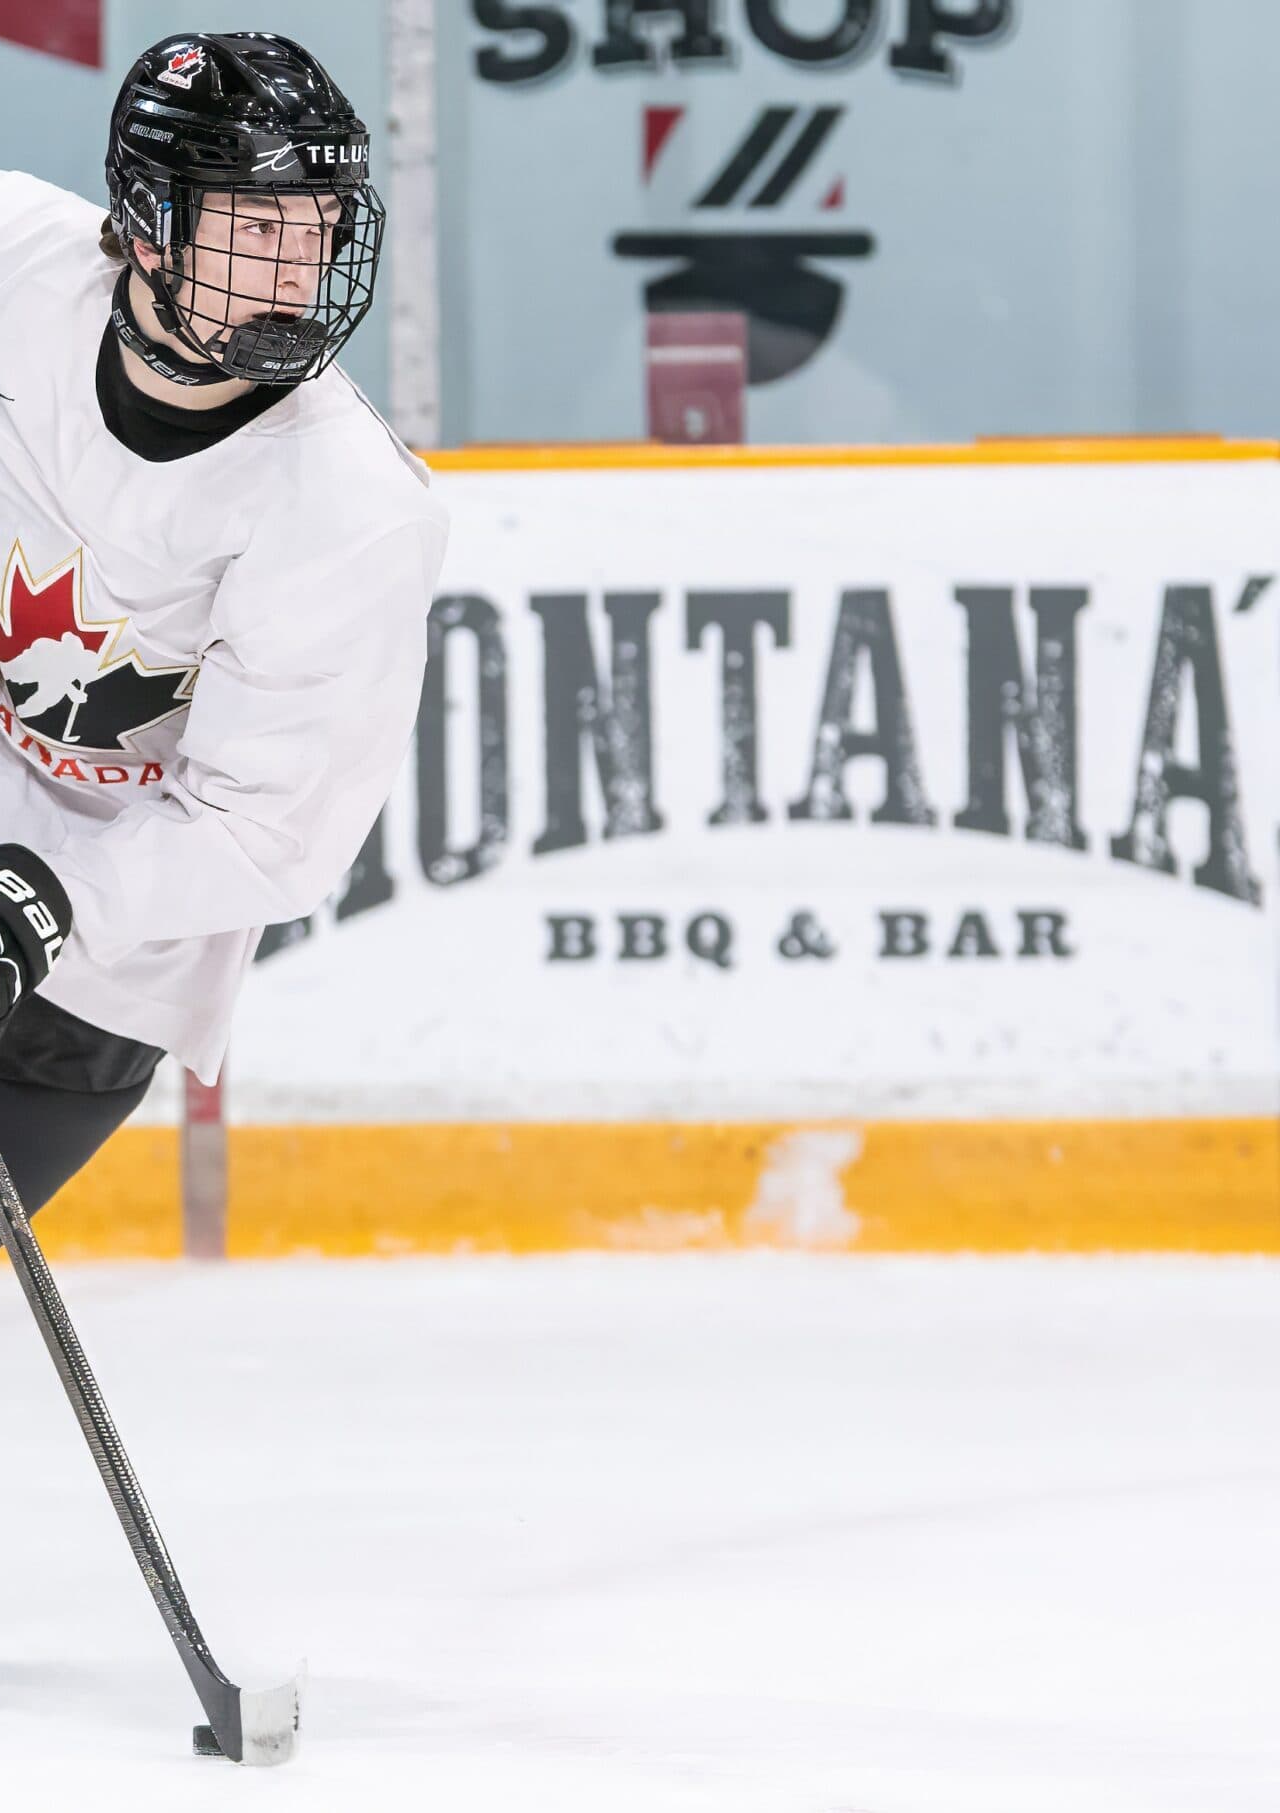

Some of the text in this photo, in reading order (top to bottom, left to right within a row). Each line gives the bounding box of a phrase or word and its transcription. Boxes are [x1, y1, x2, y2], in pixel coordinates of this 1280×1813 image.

[255, 574, 1280, 963] ONTANA'
[545, 911, 1076, 971] BBQ & BAR
